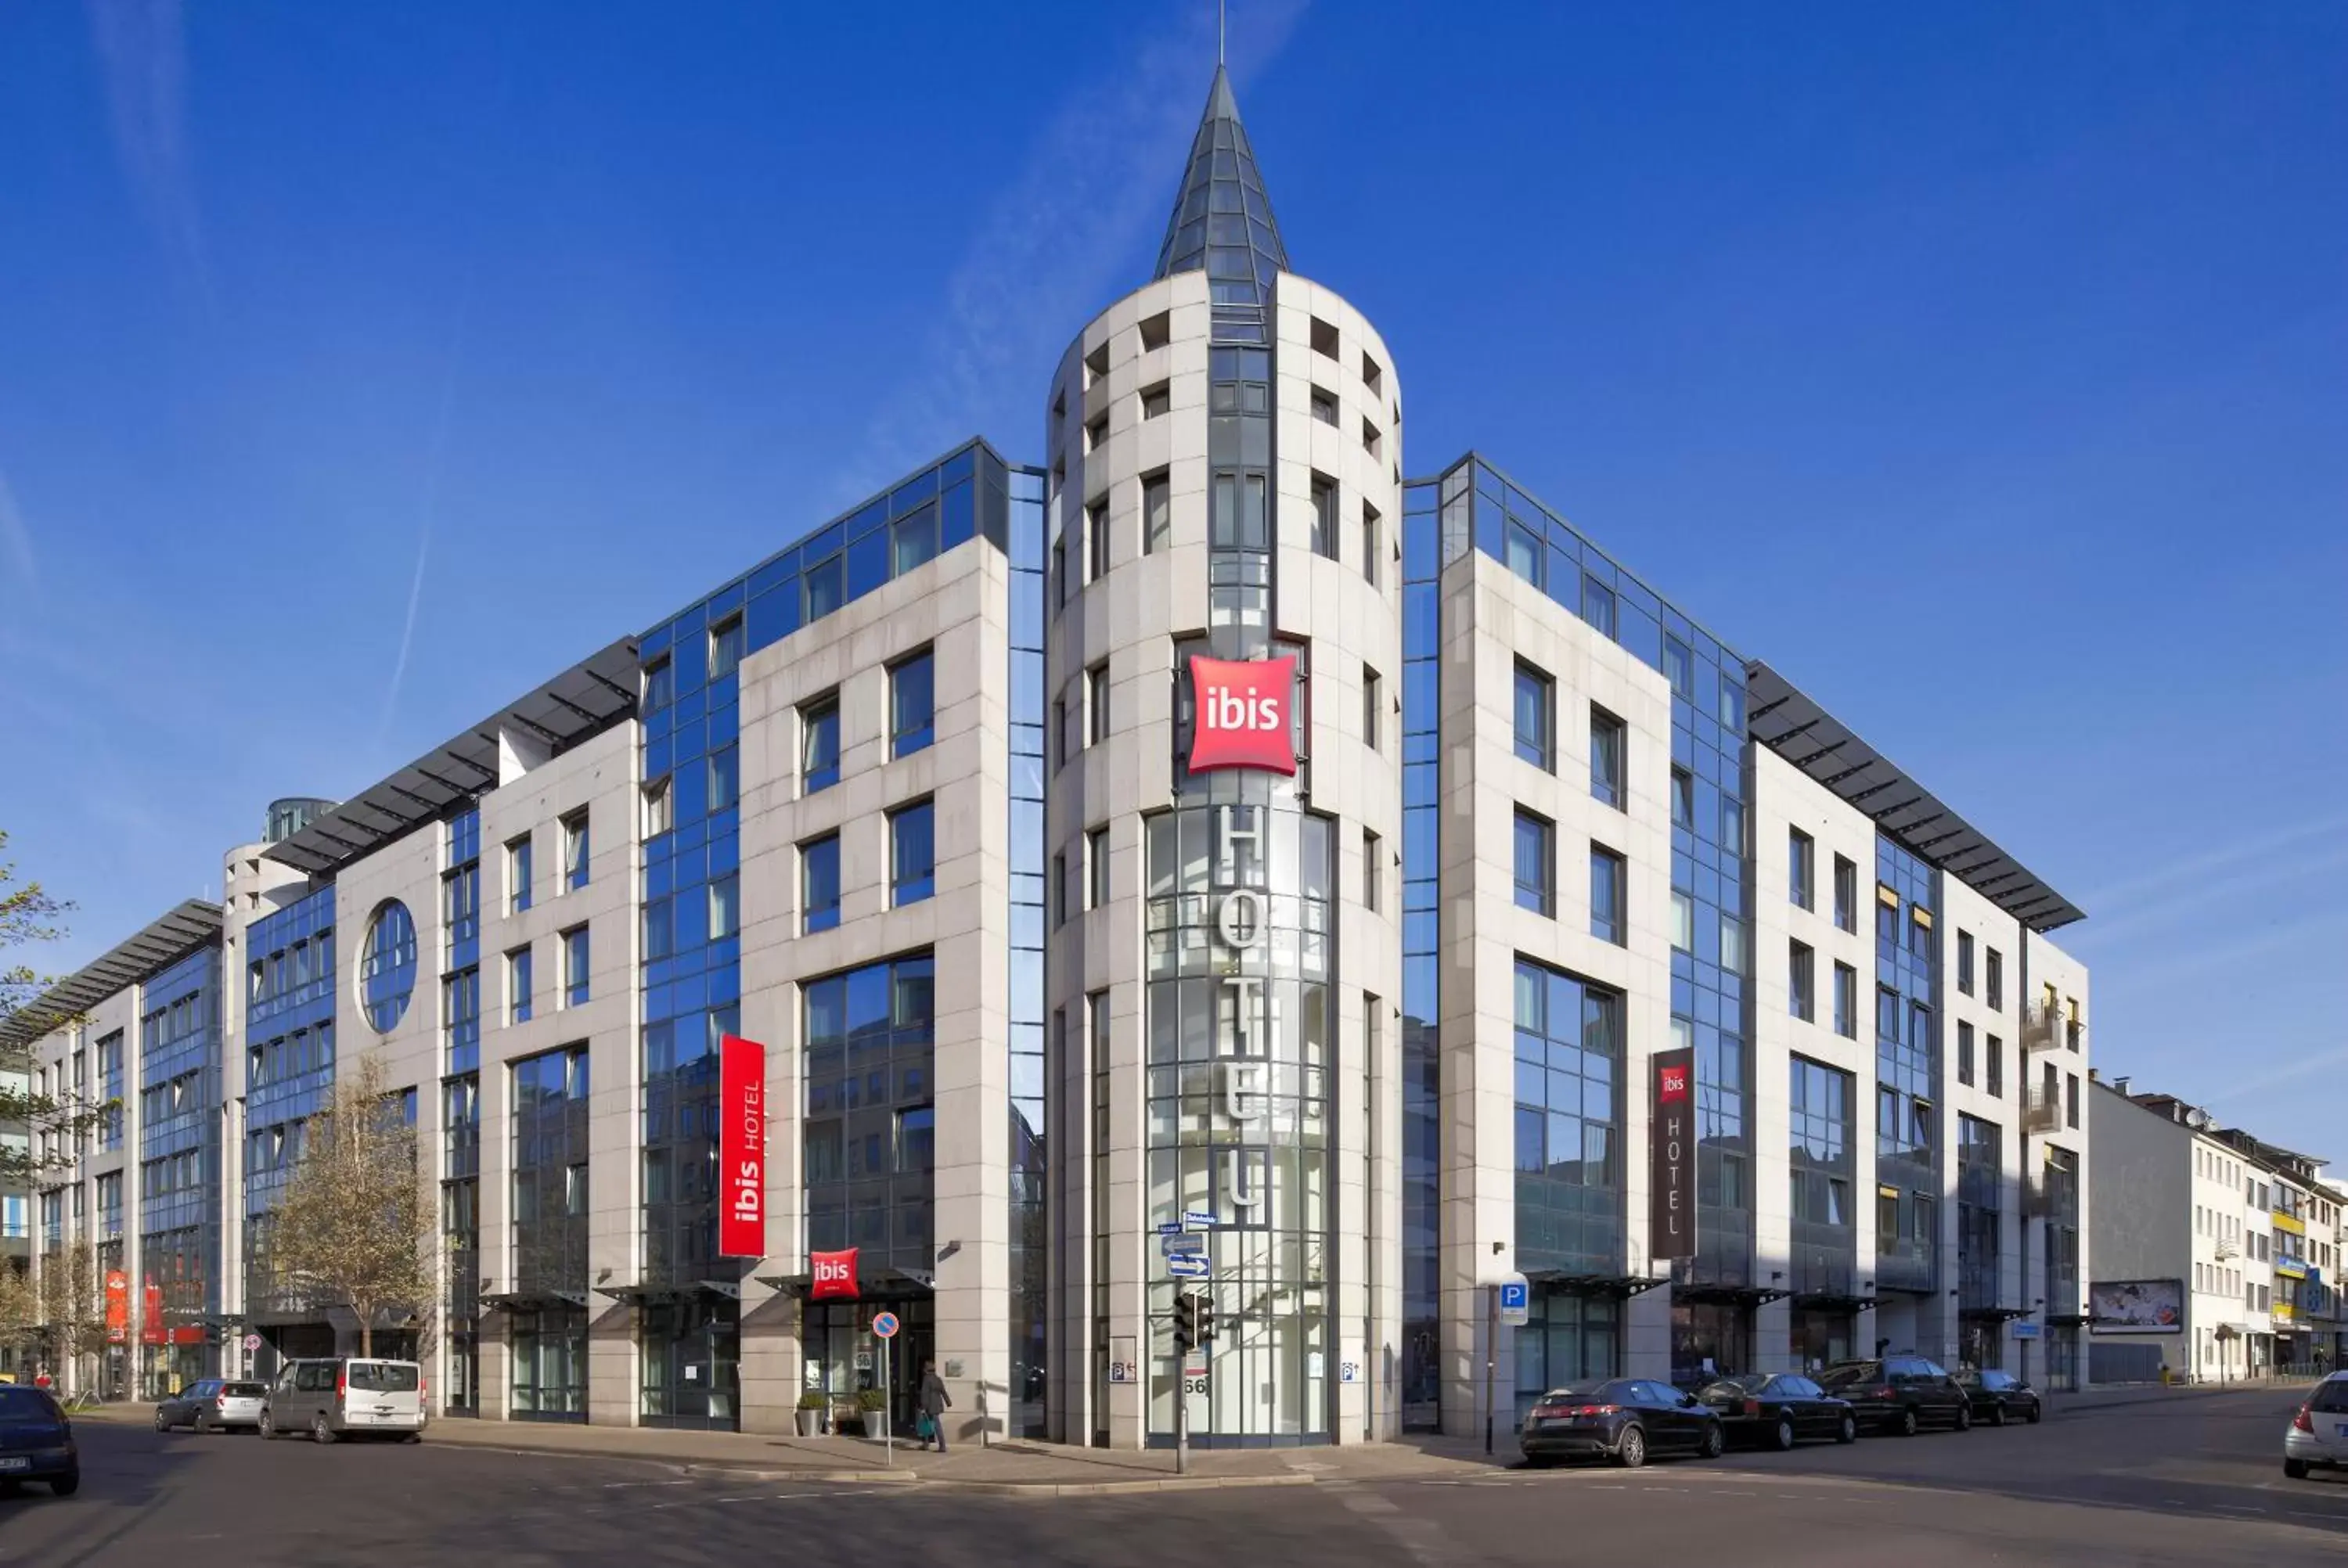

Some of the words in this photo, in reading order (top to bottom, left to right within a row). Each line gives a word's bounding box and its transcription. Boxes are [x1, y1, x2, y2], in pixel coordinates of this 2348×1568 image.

[1207, 686, 1280, 730] ibis
[1218, 804, 1265, 1207] HOTEL
[1664, 1076, 1684, 1092] ibis
[745, 1079, 759, 1151] HOTEL
[735, 1160, 759, 1222] ibis
[1667, 1117, 1680, 1235] HOTEL
[814, 1260, 849, 1281] ibis
[1507, 1287, 1521, 1305] P
[1184, 1379, 1206, 1394] 66
